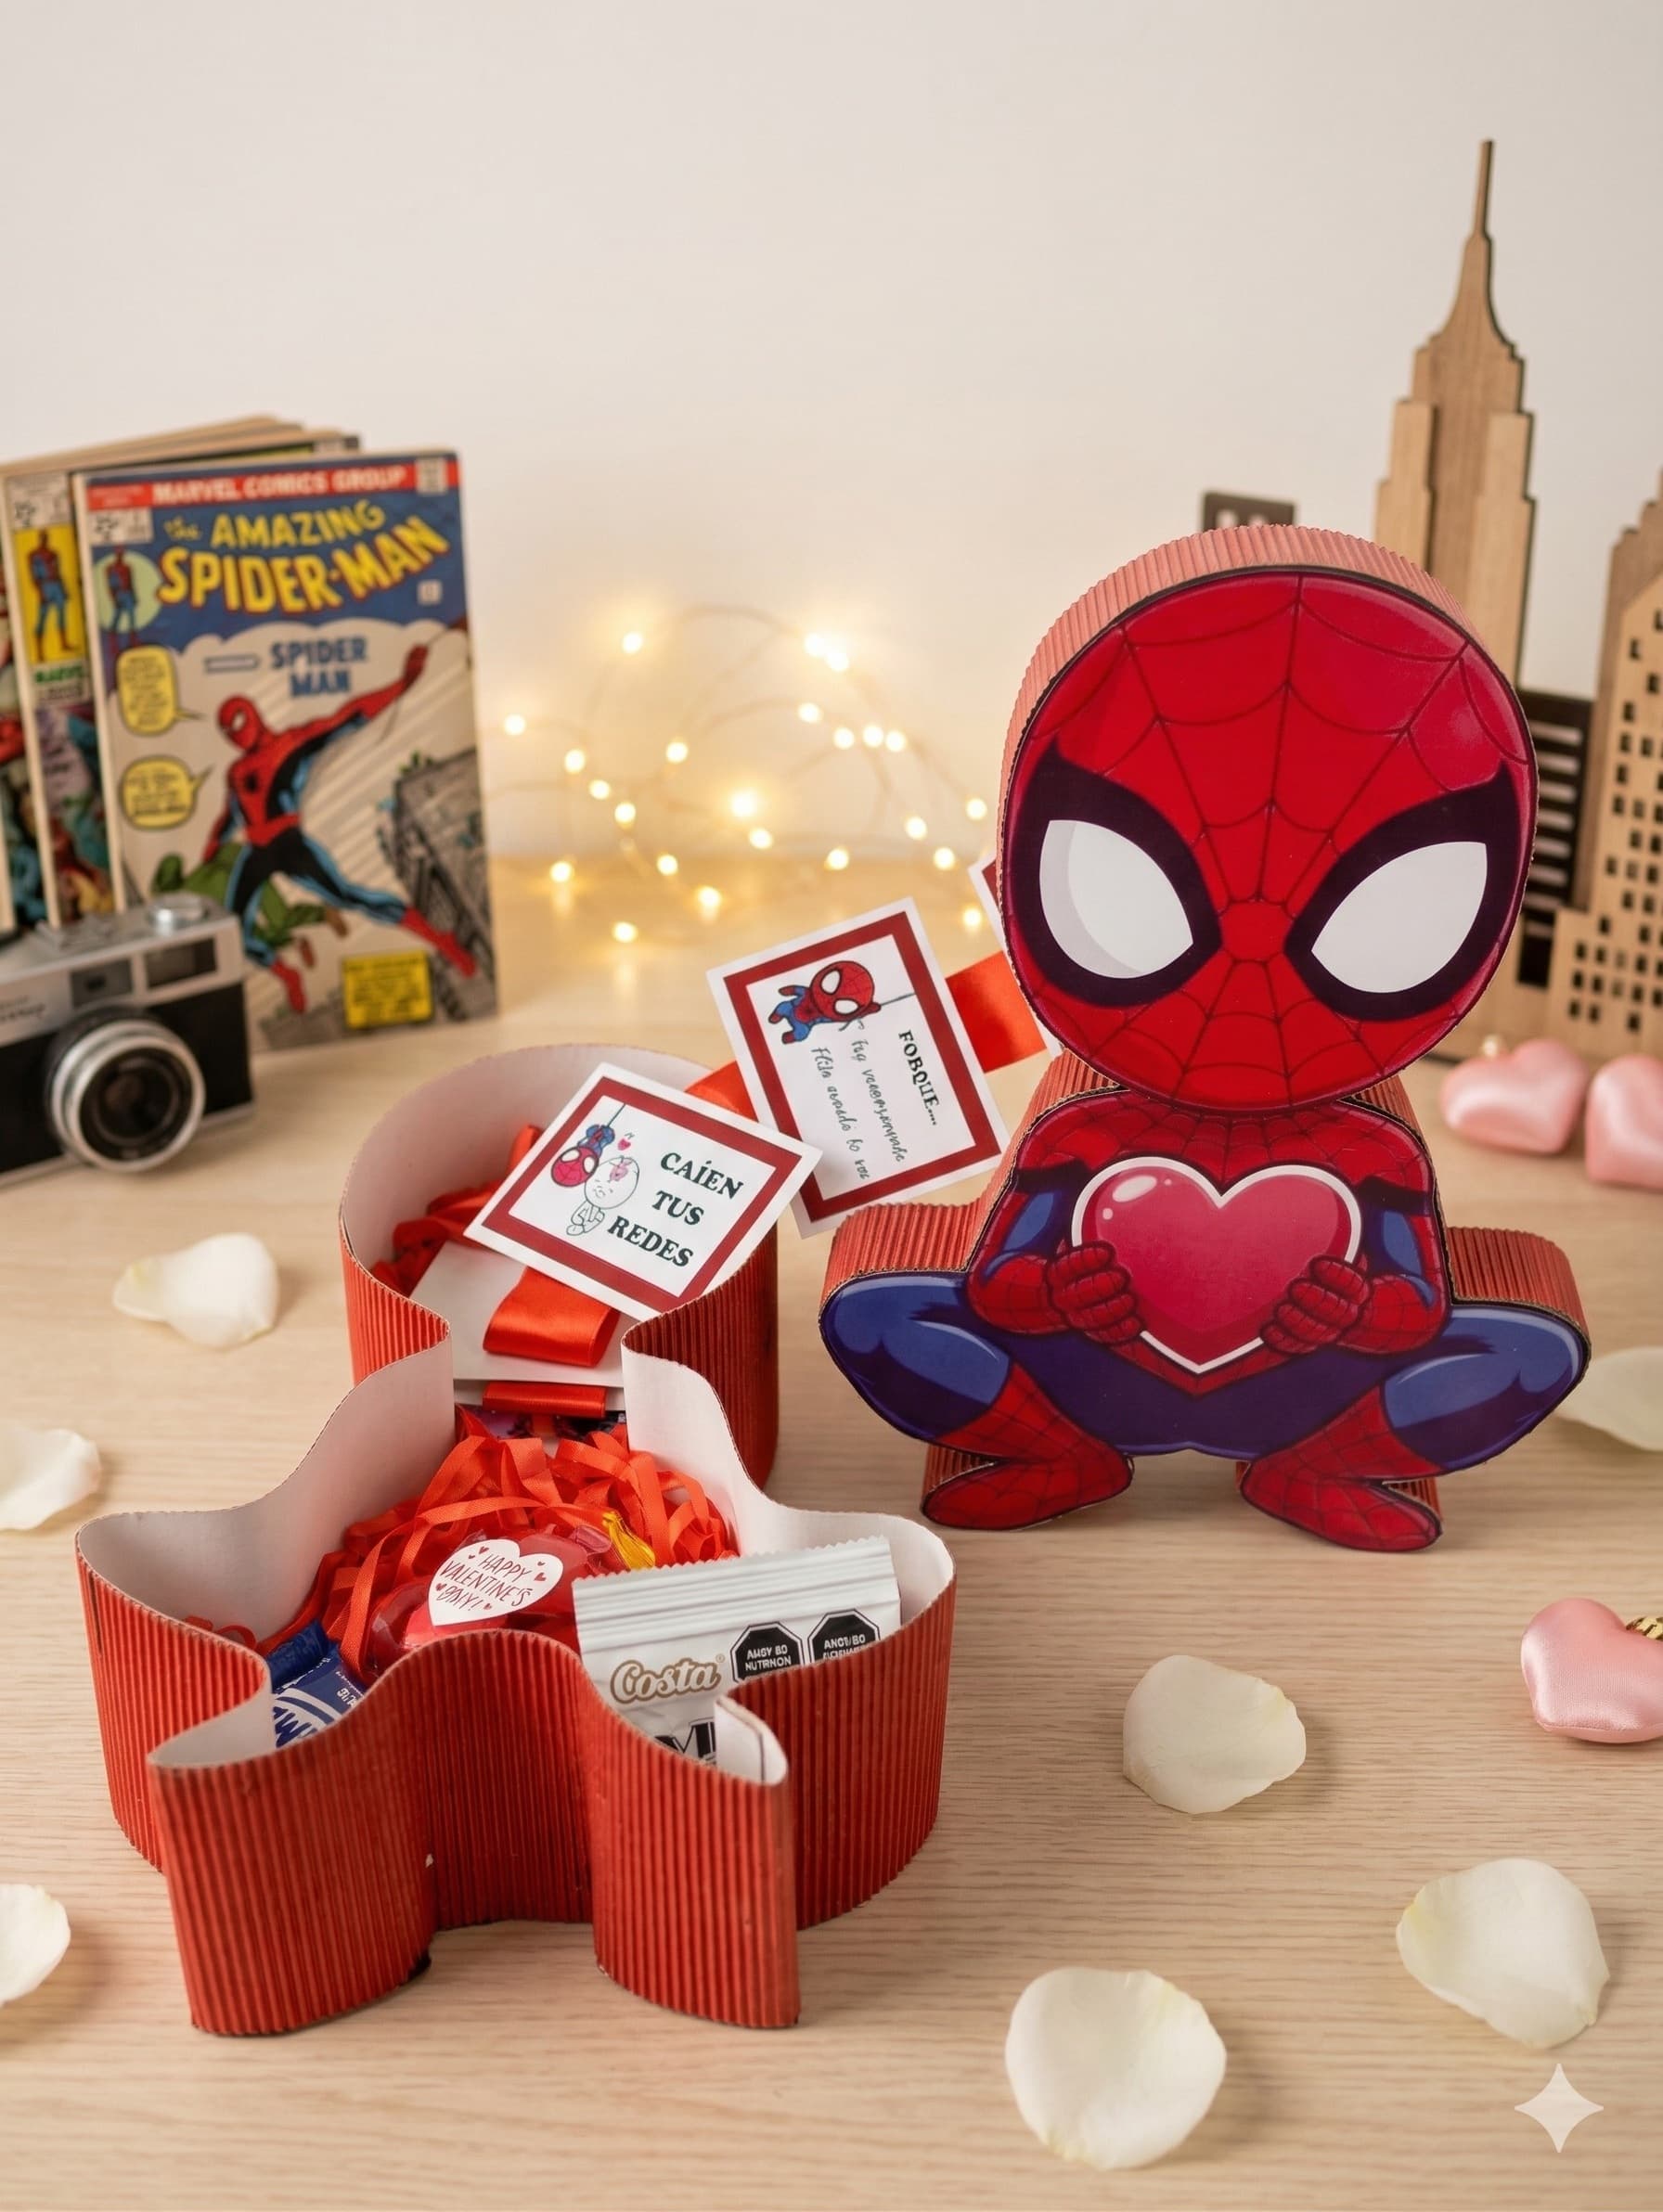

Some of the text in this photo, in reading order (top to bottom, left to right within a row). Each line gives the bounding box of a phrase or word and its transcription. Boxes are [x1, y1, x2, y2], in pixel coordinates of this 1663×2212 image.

[152, 478, 241, 505] MARVEL
[243, 470, 329, 498] COMICS
[331, 465, 406, 492] GROUP
[211, 499, 386, 548] AMAZING
[156, 515, 449, 613] SPIDER-MAN
[270, 637, 367, 669] SPIDER
[290, 669, 352, 699] MAN
[660, 1152, 744, 1199] CAÍEN
[651, 1190, 704, 1225] TUS
[607, 1215, 693, 1267] REDES
[440, 1561, 534, 1607] VALENTINE'S
[478, 1553, 533, 1583] HAPPY
[610, 1657, 722, 1704] Costa
